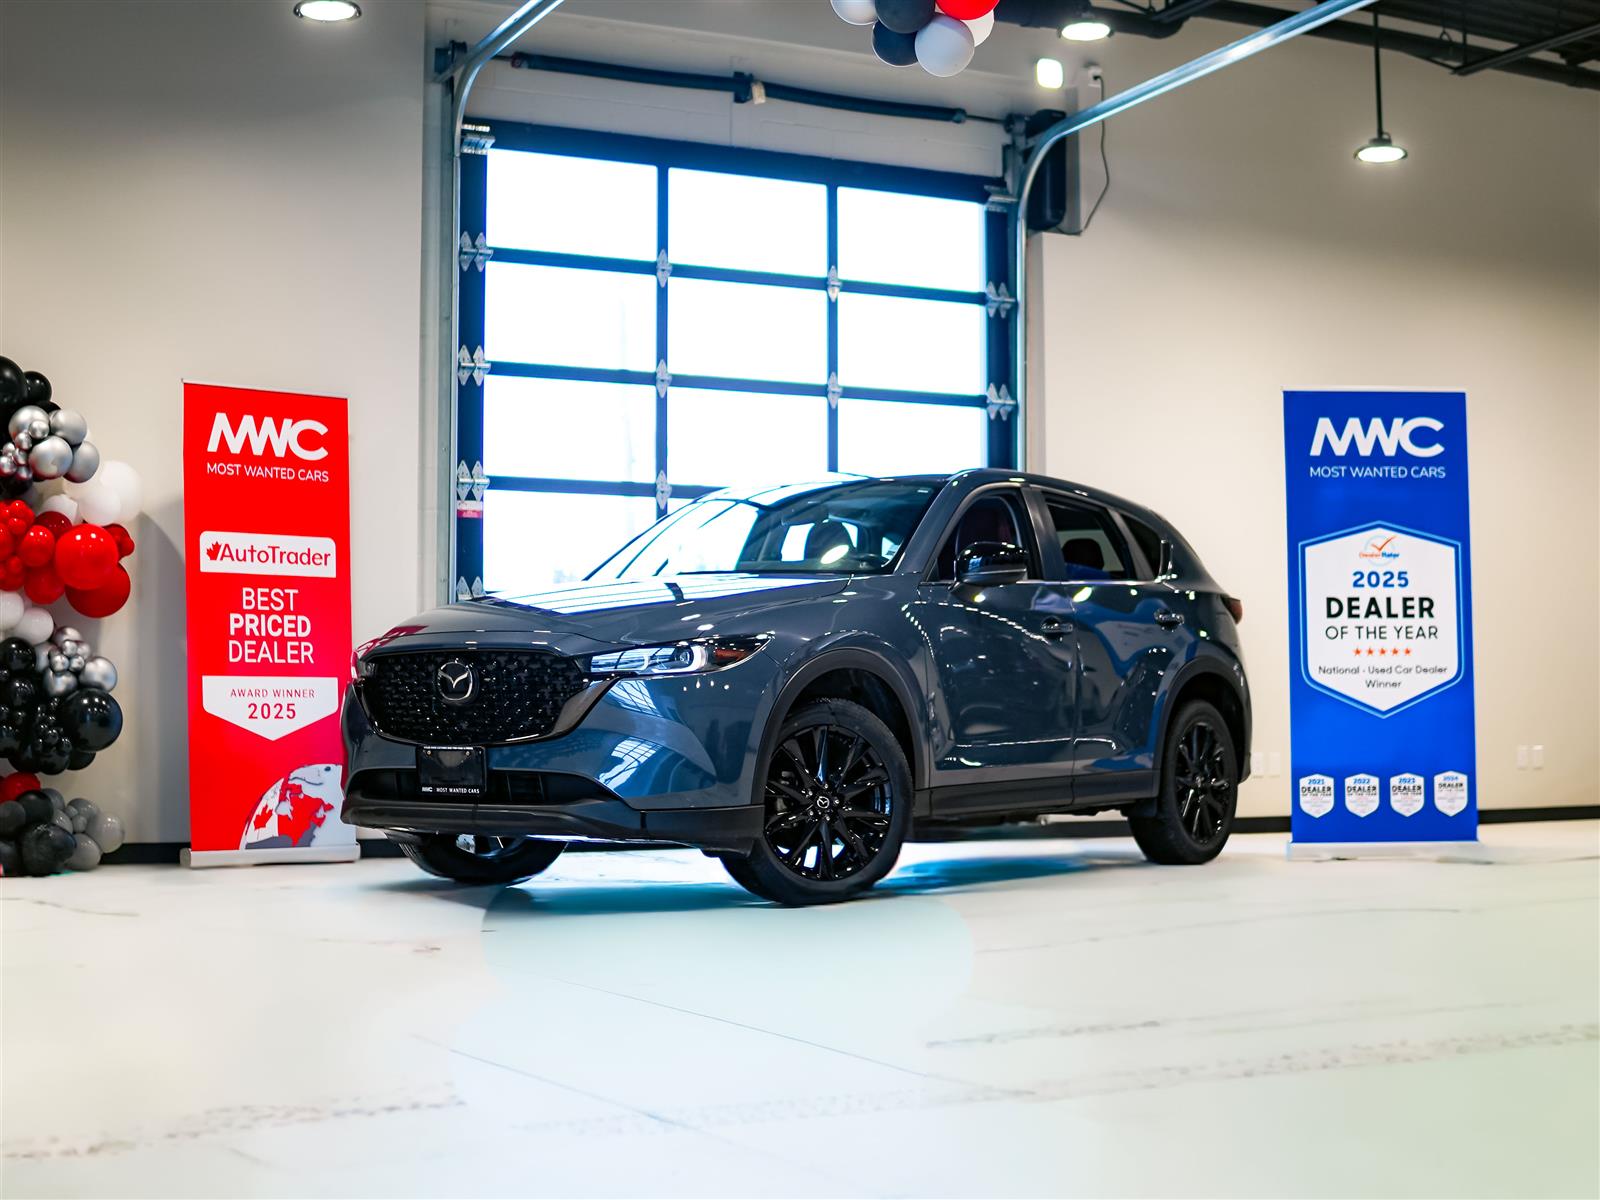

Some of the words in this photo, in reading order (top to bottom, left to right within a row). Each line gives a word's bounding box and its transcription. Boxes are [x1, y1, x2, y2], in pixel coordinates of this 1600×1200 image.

[207, 412, 329, 461] MWC
[1309, 416, 1445, 458] MWC
[206, 462, 241, 476] MOST
[244, 465, 295, 480] WANTED
[298, 469, 329, 483] CARS
[1309, 466, 1347, 479] MOST
[1350, 466, 1408, 479] WANTED
[1411, 466, 1446, 479] CARS
[219, 543, 331, 567] AutoTrader
[1352, 571, 1409, 588] 2025
[242, 587, 299, 612] BEST
[1326, 596, 1435, 619] DEALER
[229, 613, 312, 638] PRICED
[1325, 625, 1348, 640] OF
[1355, 625, 1387, 640] THE
[1394, 625, 1439, 640] YEAR
[228, 640, 314, 664] DEALER
[1318, 666, 1360, 675] National
[1368, 666, 1392, 674] Used
[1395, 665, 1412, 674] Car
[1416, 665, 1448, 674] Dealer
[1365, 679, 1402, 688] Winner
[230, 688, 268, 698] AWARD
[273, 689, 315, 699] WINNER
[247, 703, 297, 720] 2025
[1301, 786, 1332, 794] DEALER
[1346, 785, 1377, 793] DEALER
[1392, 785, 1422, 793] DEALER
